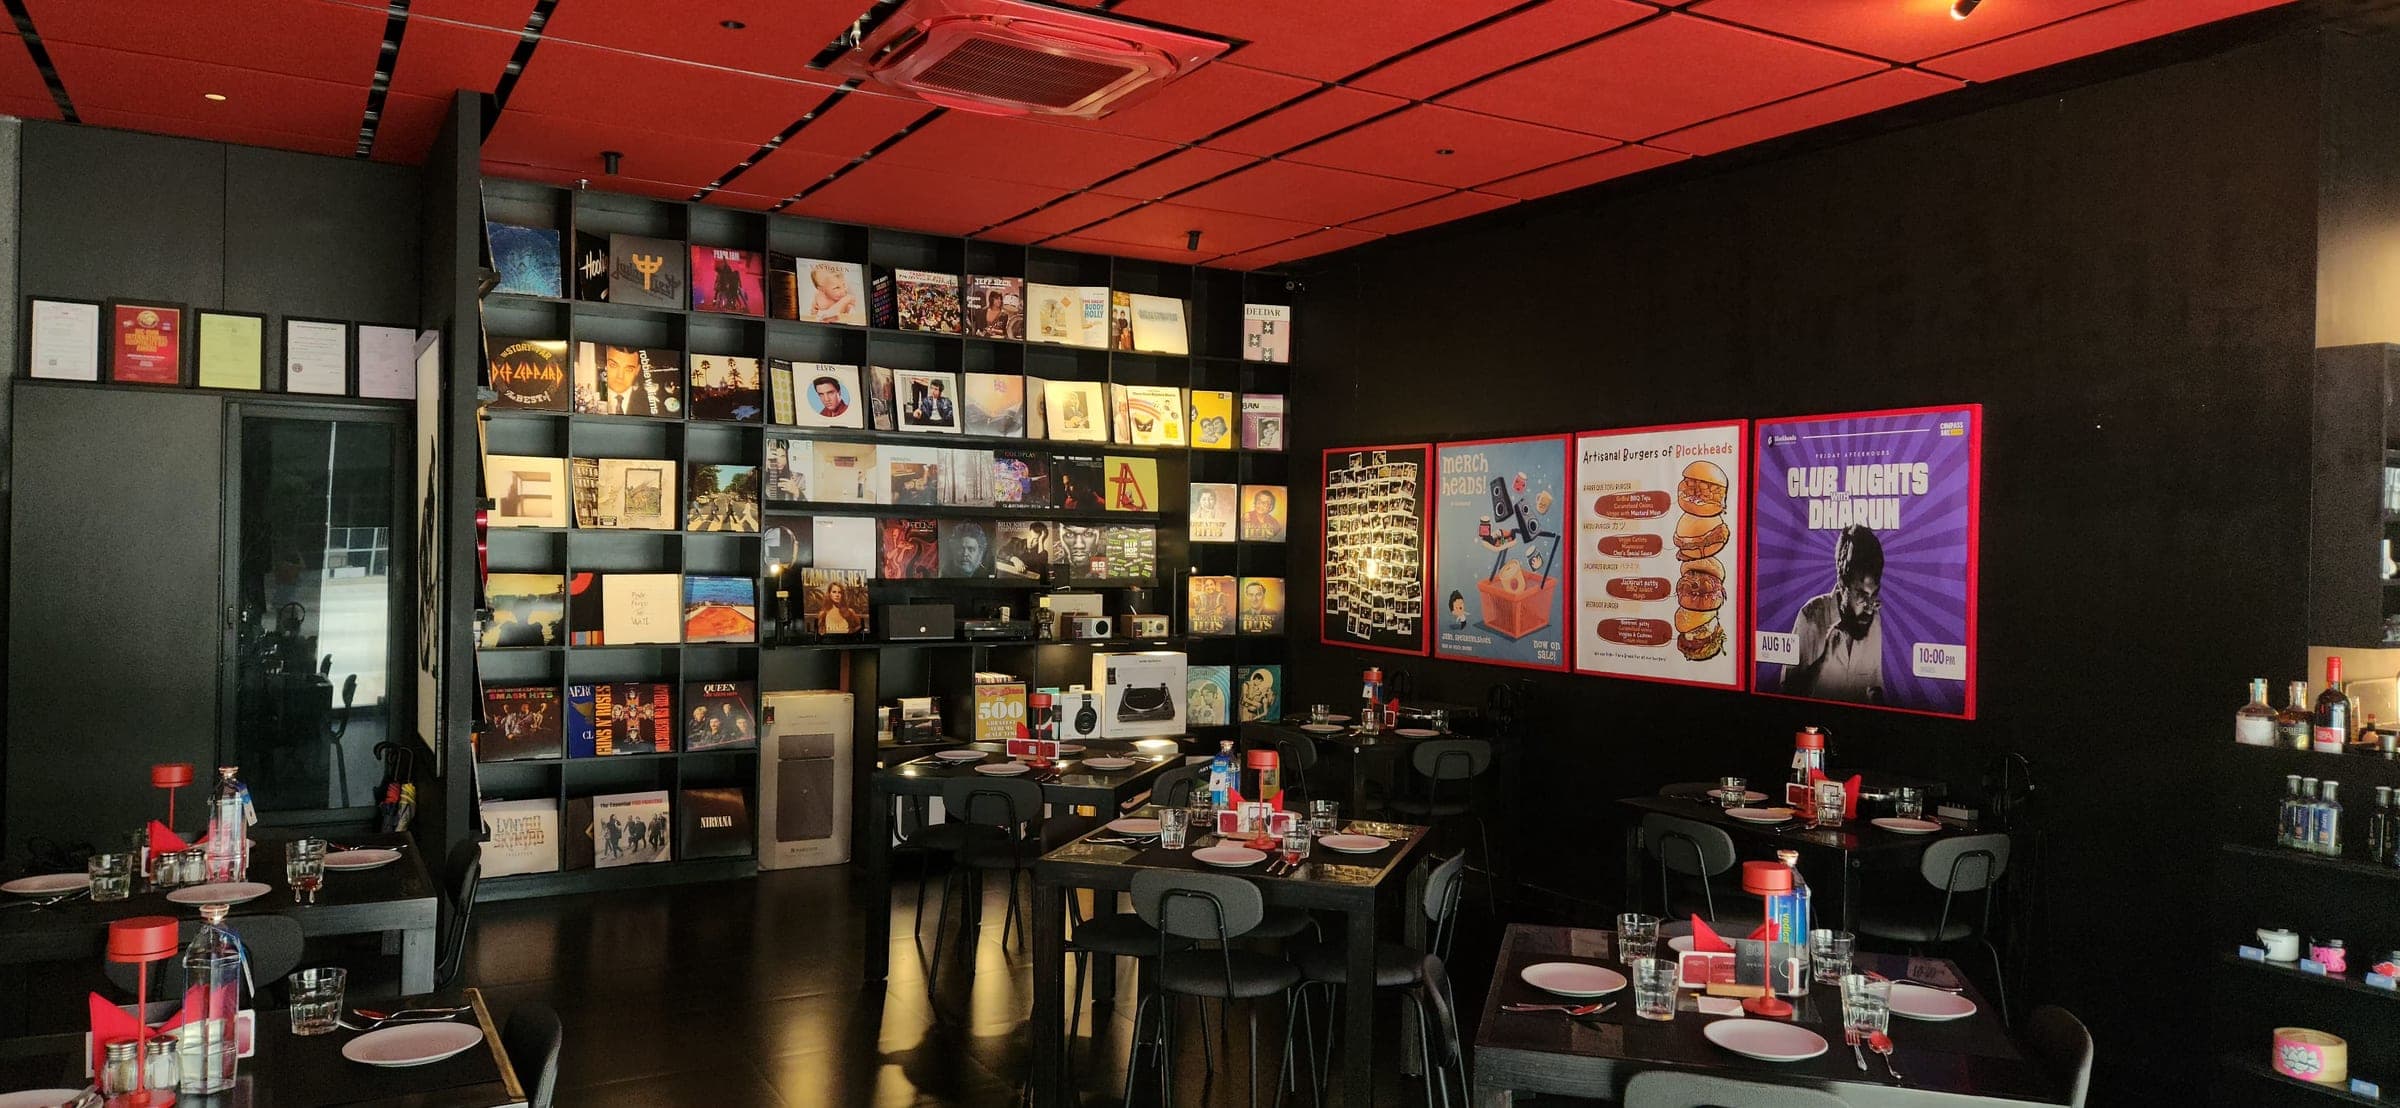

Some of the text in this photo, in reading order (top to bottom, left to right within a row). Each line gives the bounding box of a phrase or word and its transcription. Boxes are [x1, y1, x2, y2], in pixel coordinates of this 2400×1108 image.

[1084, 310, 1104, 319] HOLLY
[638, 350, 651, 378] robbie
[491, 360, 564, 388] DEF LEPPARD
[516, 394, 543, 404] BEST
[1582, 442, 1733, 464] Artisanal Burgers of Blockheads
[1844, 449, 1890, 458] AFTERHOURS
[1787, 462, 1929, 498] CLUB NIGHTS
[1830, 491, 1850, 502] WITH
[1808, 497, 1901, 530] DHARUN
[847, 569, 867, 588] REY
[1533, 639, 1561, 651] now on
[1761, 635, 1779, 652] AUG
[1919, 647, 1956, 666] 10:00 PM
[488, 691, 554, 700] SMASH HITS
[704, 683, 736, 694] QUEEN
[595, 685, 611, 716] ROSES
[977, 701, 1024, 719] 500
[595, 729, 612, 755] GUNS
[700, 815, 732, 829] NIRVANA
